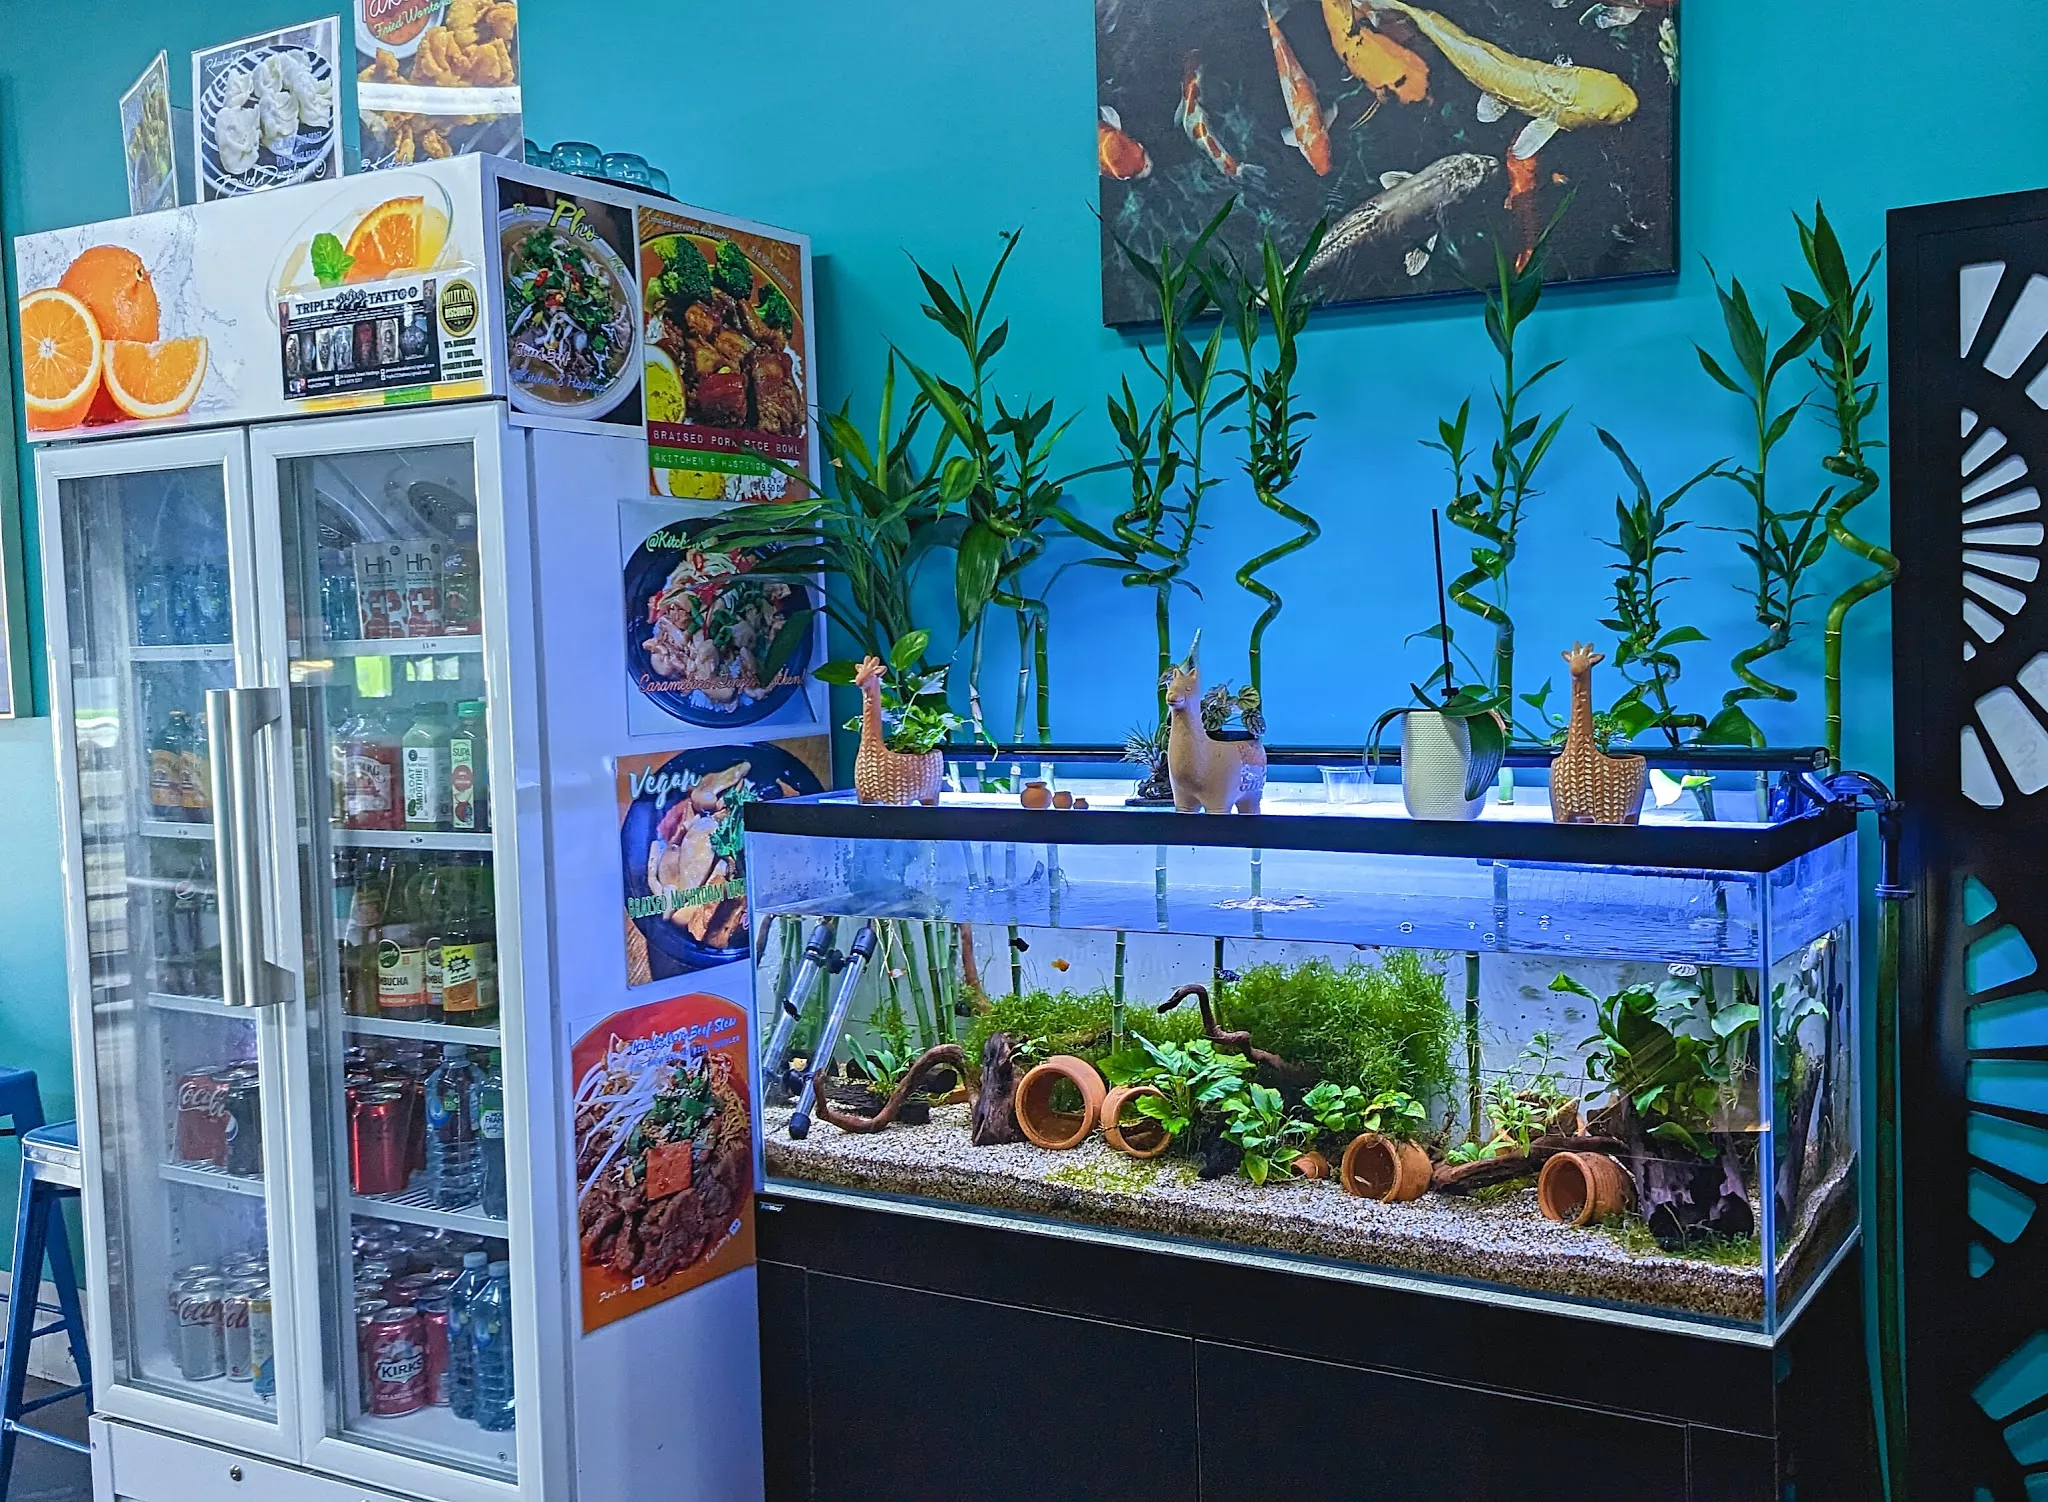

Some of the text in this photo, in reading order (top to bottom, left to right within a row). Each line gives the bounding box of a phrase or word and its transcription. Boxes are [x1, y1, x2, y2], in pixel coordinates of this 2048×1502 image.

[549, 198, 601, 241] Pho
[296, 299, 335, 314] TRIPLE
[367, 286, 418, 304] TATTOO
[443, 289, 473, 304] MILITARY
[445, 305, 473, 318] DISCOUNTS
[653, 430, 704, 444] BRAISED
[776, 443, 800, 455] BOWL
[365, 556, 392, 574] Hh
[406, 554, 432, 571] Hh
[629, 766, 700, 810] Vegan
[627, 894, 667, 919] BRAISED
[688, 1021, 712, 1040] Beef
[714, 1016, 736, 1032] Stew
[382, 1358, 422, 1378] KIRKS
